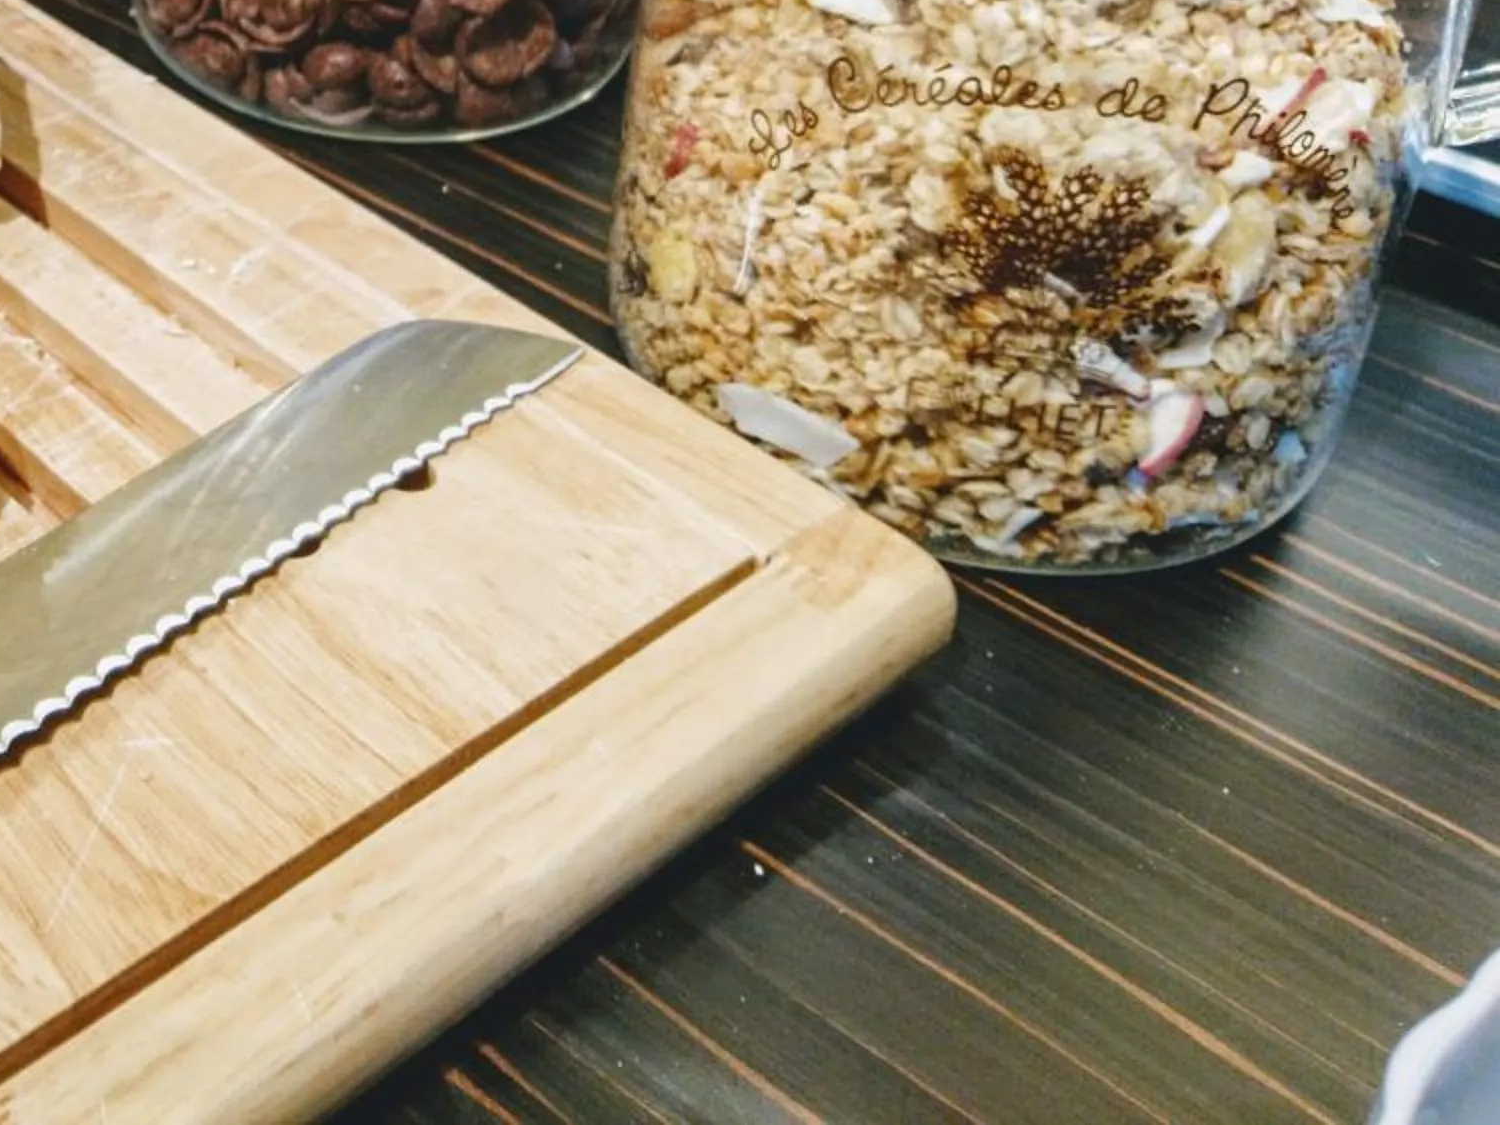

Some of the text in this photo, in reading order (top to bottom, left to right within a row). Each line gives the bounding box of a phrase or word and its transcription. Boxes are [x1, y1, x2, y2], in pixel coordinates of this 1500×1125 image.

[748, 100, 819, 171] Les
[826, 56, 1066, 113] Céréales
[1095, 76, 1169, 122] de
